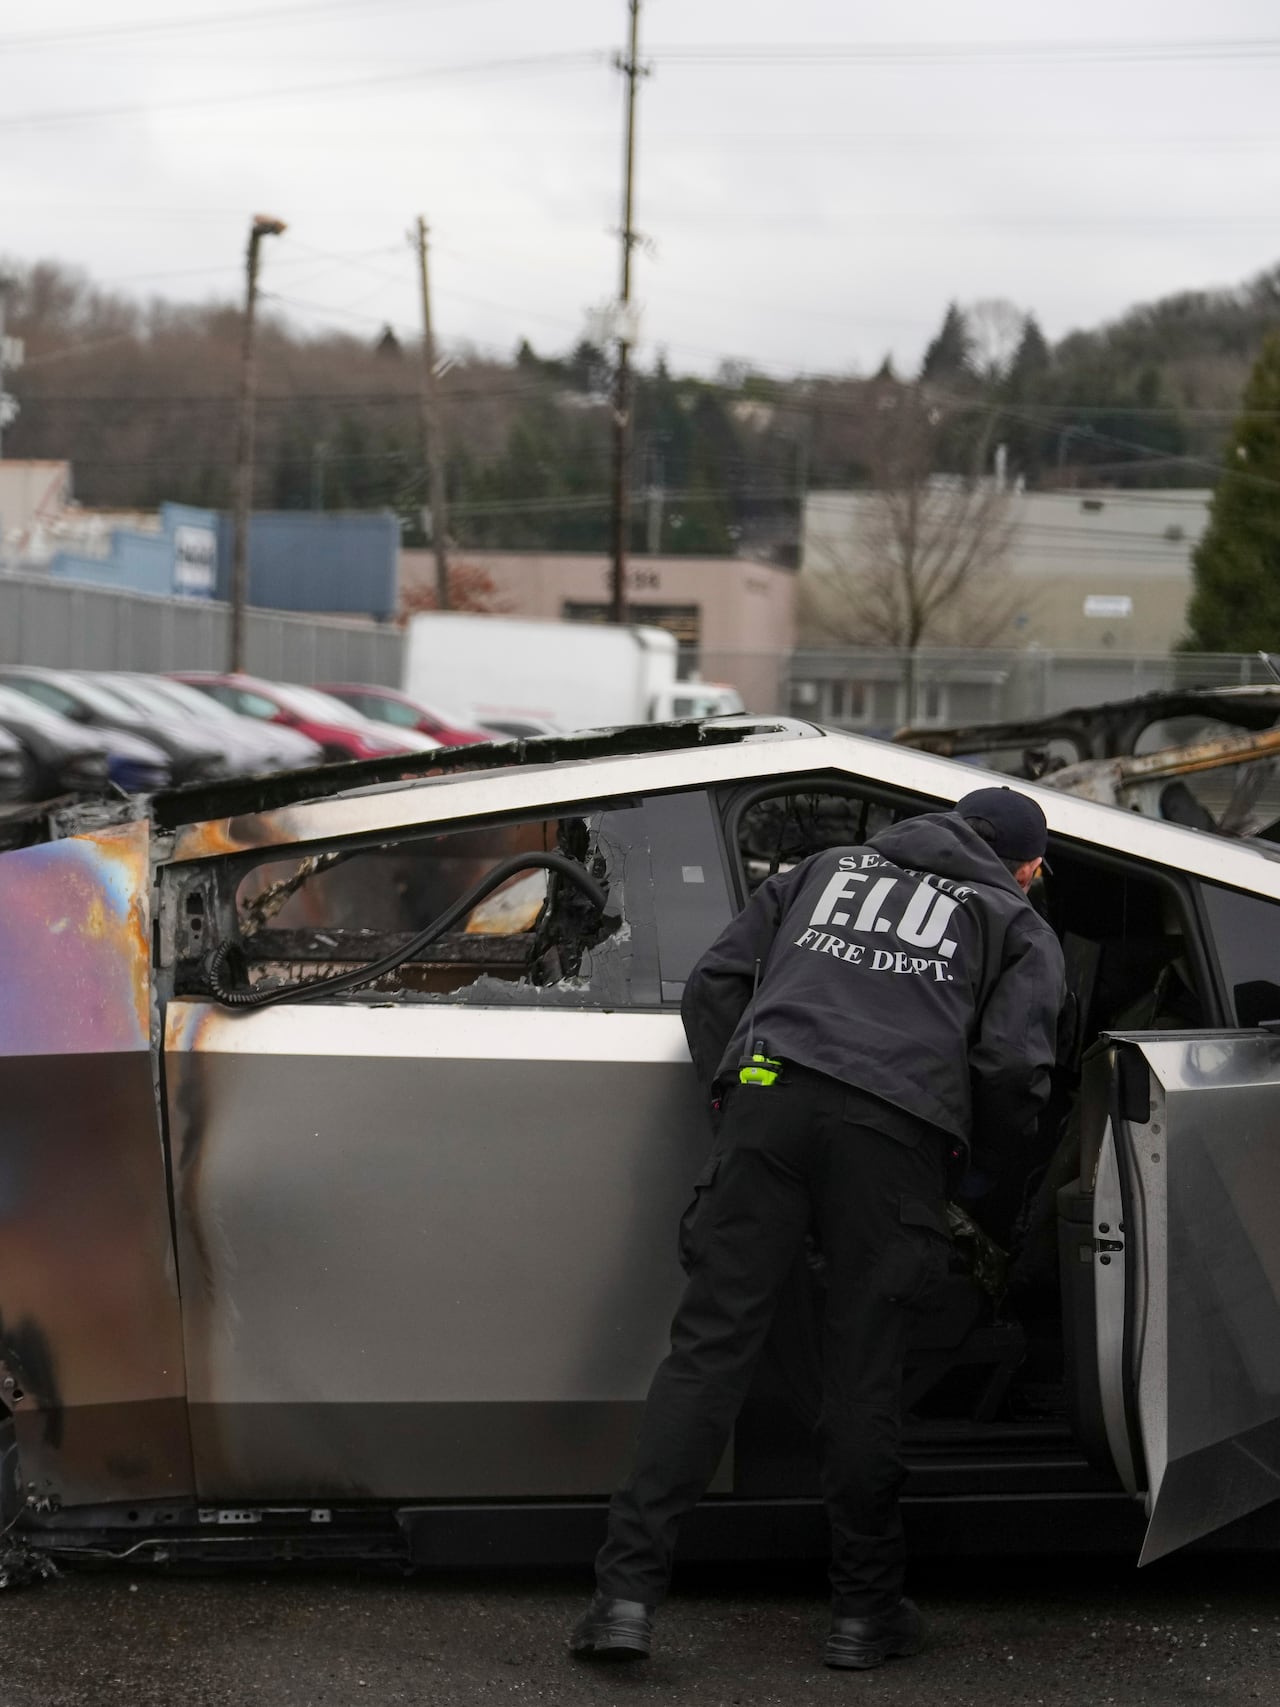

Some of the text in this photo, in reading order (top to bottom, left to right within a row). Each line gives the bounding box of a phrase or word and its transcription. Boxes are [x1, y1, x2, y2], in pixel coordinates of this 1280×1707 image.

[838, 853, 978, 903] SELE
[808, 870, 959, 959] F.I.U.
[793, 927, 954, 983] FIRE DEPT.
